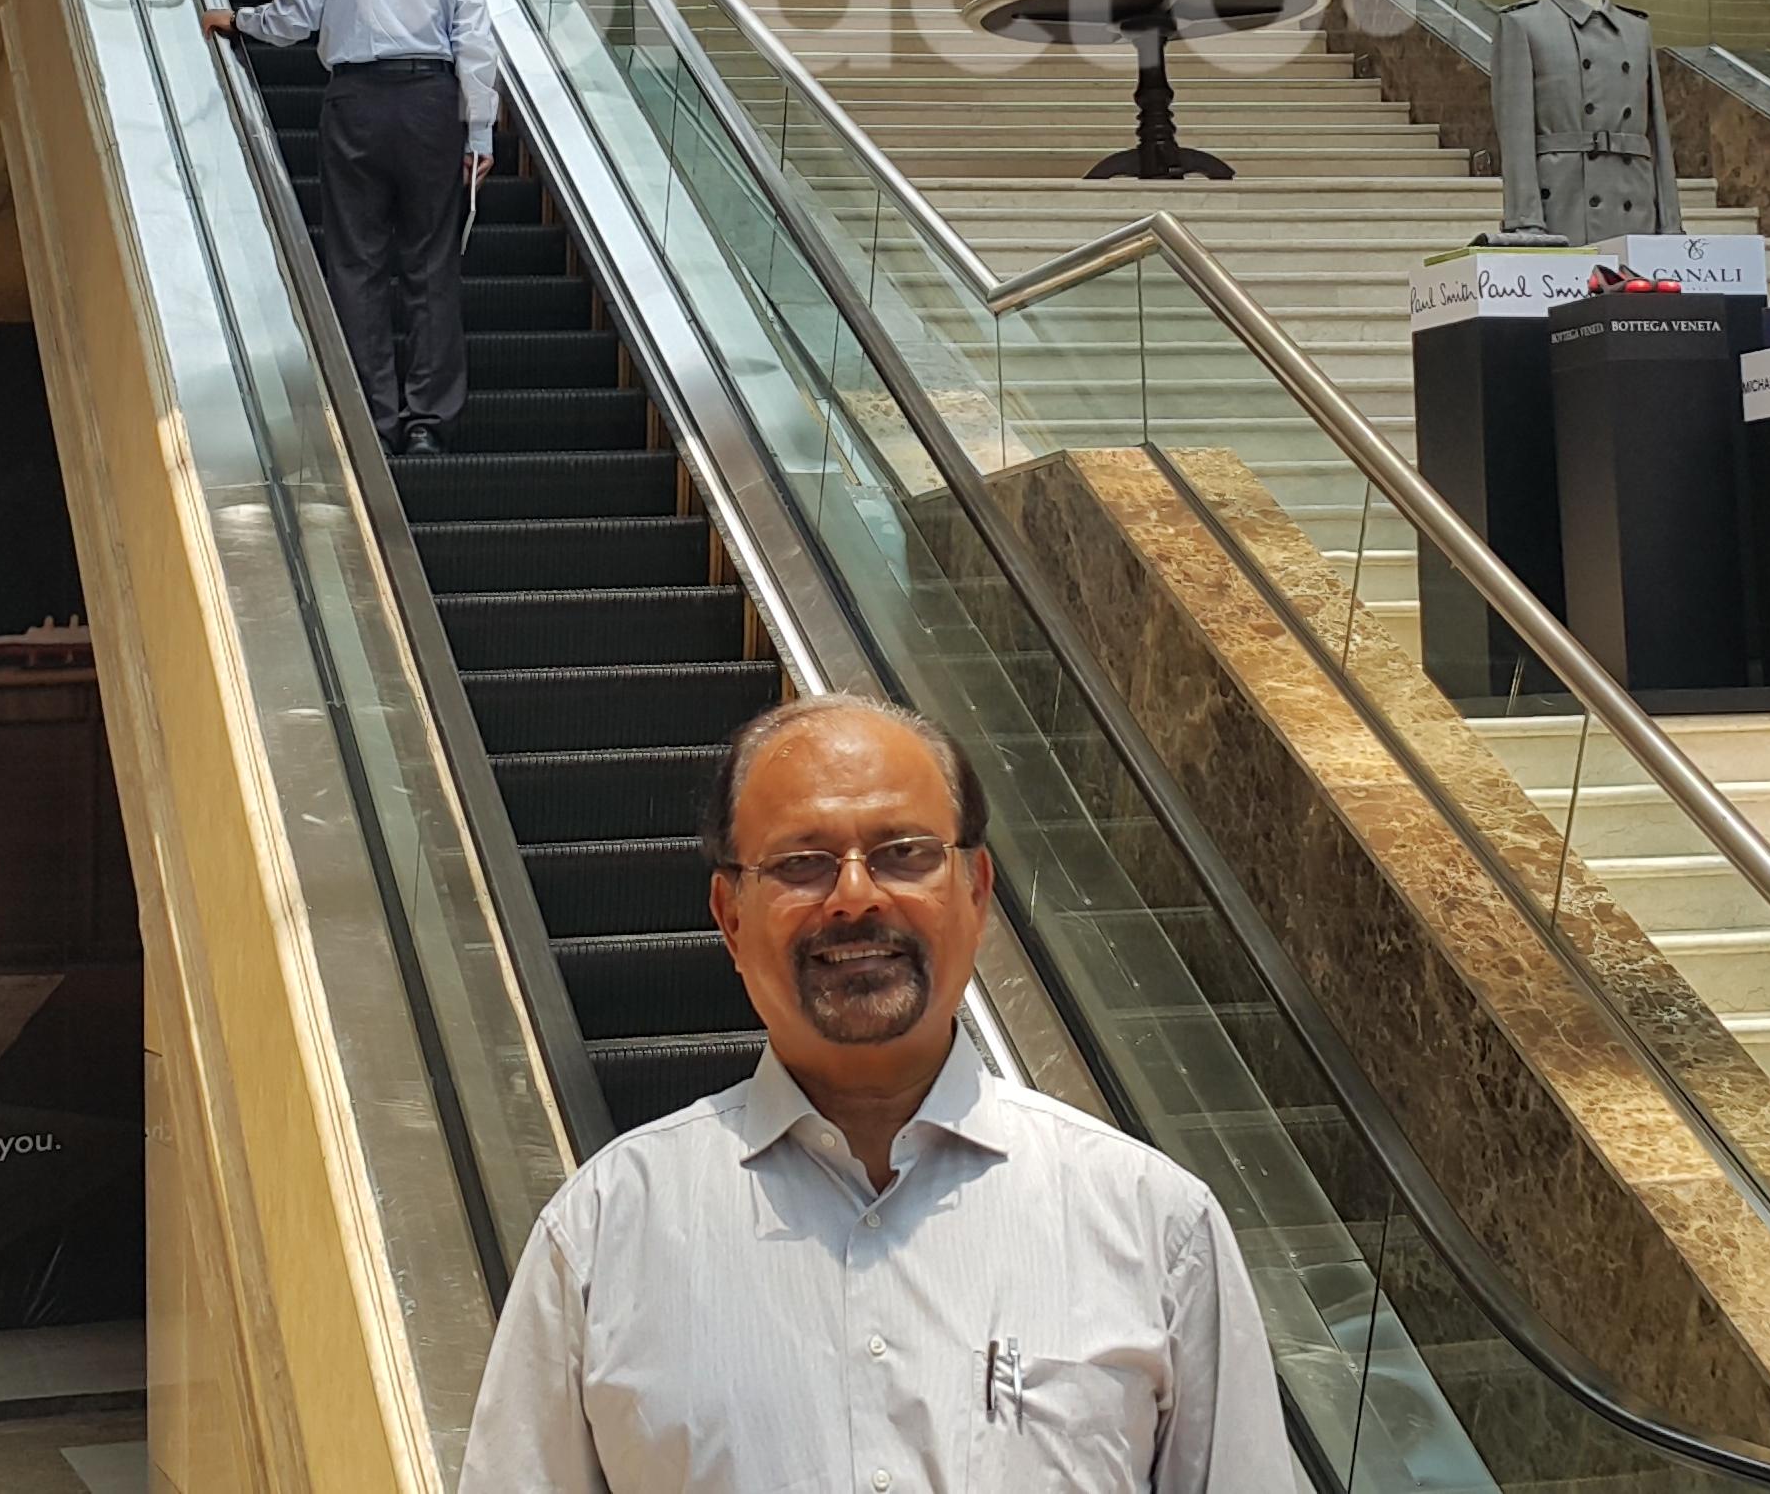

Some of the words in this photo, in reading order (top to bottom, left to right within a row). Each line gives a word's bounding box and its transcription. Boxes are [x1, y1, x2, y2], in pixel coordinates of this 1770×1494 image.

[1478, 270, 1532, 299] Paul
[1542, 274, 1591, 299] Smi
[1652, 268, 1742, 283] CANALI
[1410, 286, 1437, 314] Paul
[1440, 281, 1478, 306] Smith
[1610, 320, 1669, 332] BOTTEGA
[1670, 320, 1722, 332] VENETA
